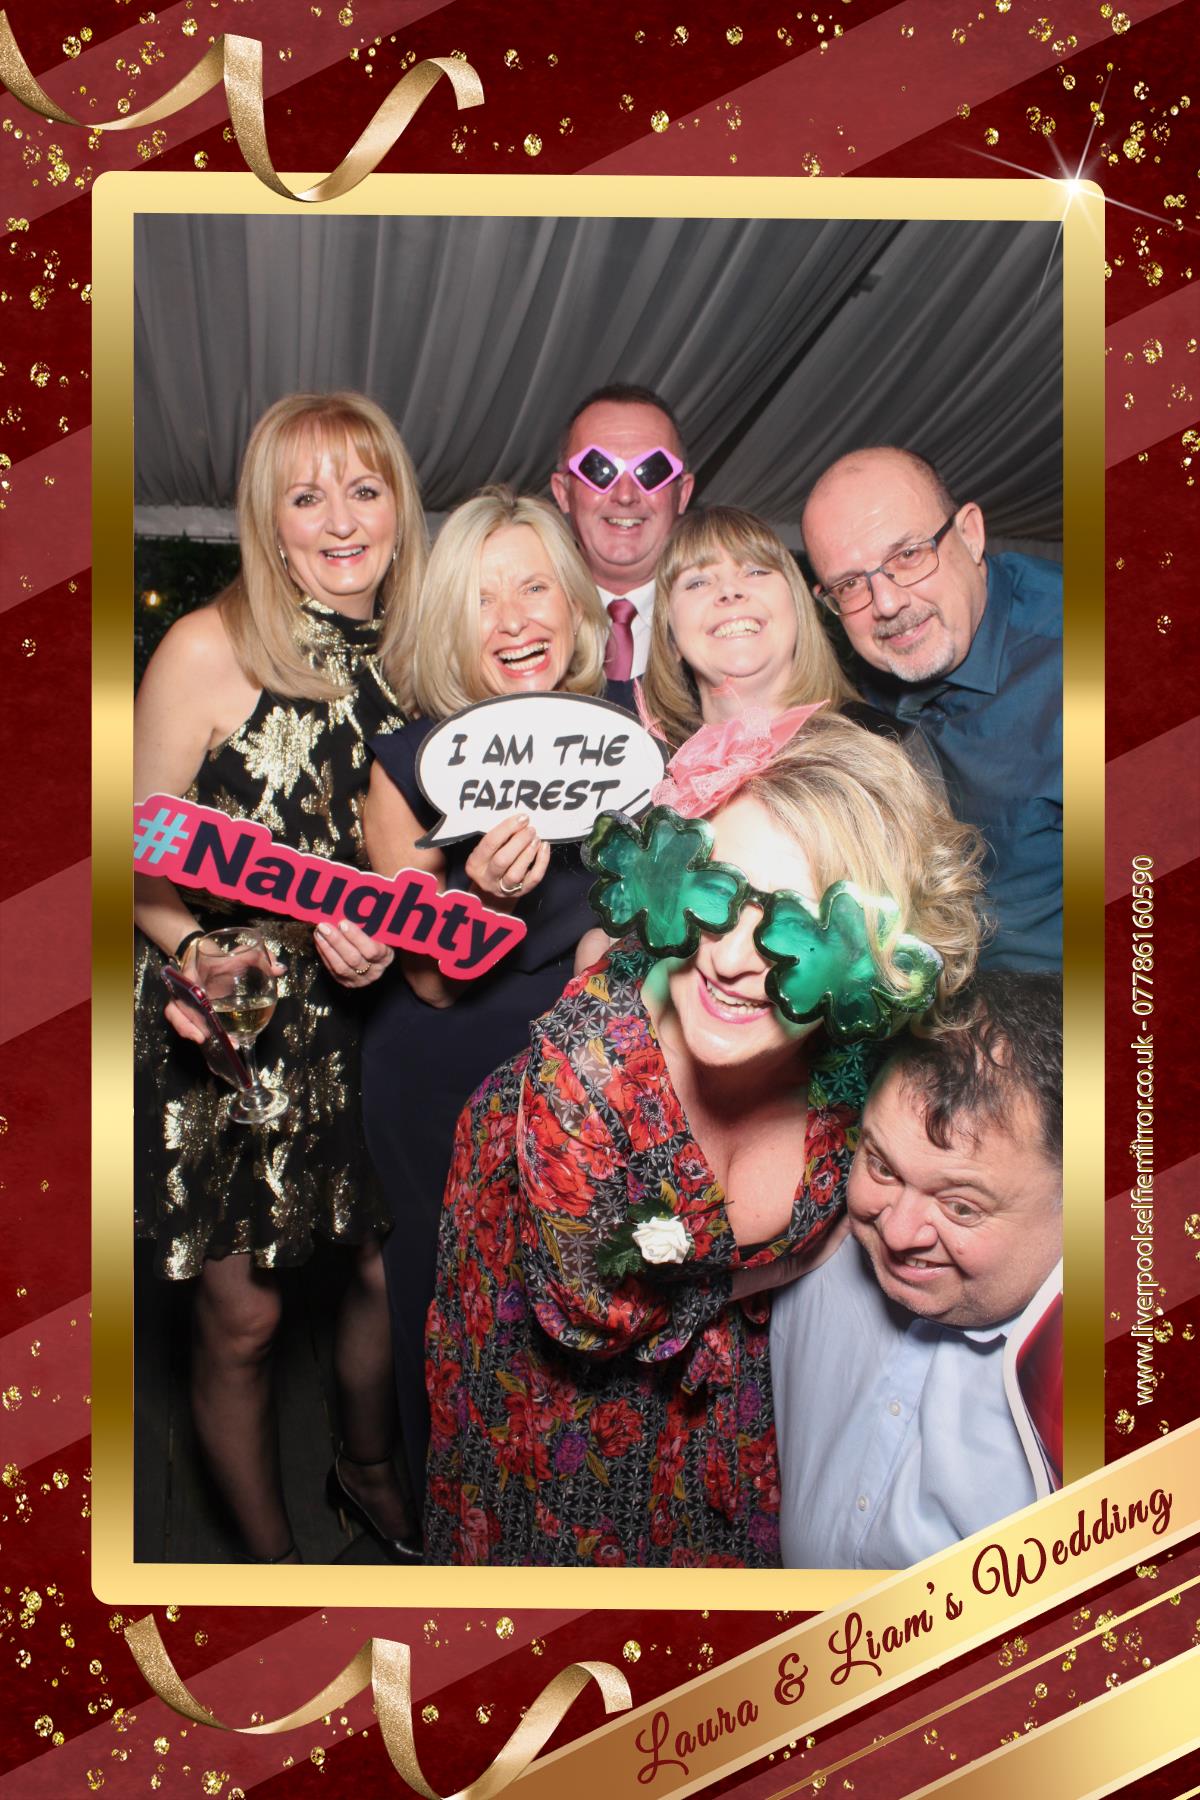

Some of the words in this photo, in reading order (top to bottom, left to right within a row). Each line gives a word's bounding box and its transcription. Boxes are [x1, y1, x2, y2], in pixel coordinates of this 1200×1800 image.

[448, 734, 468, 766] I
[482, 734, 534, 767] AM
[553, 734, 630, 767] THE
[459, 779, 621, 811] FAIREST
[134, 807, 512, 969] #Naughty
